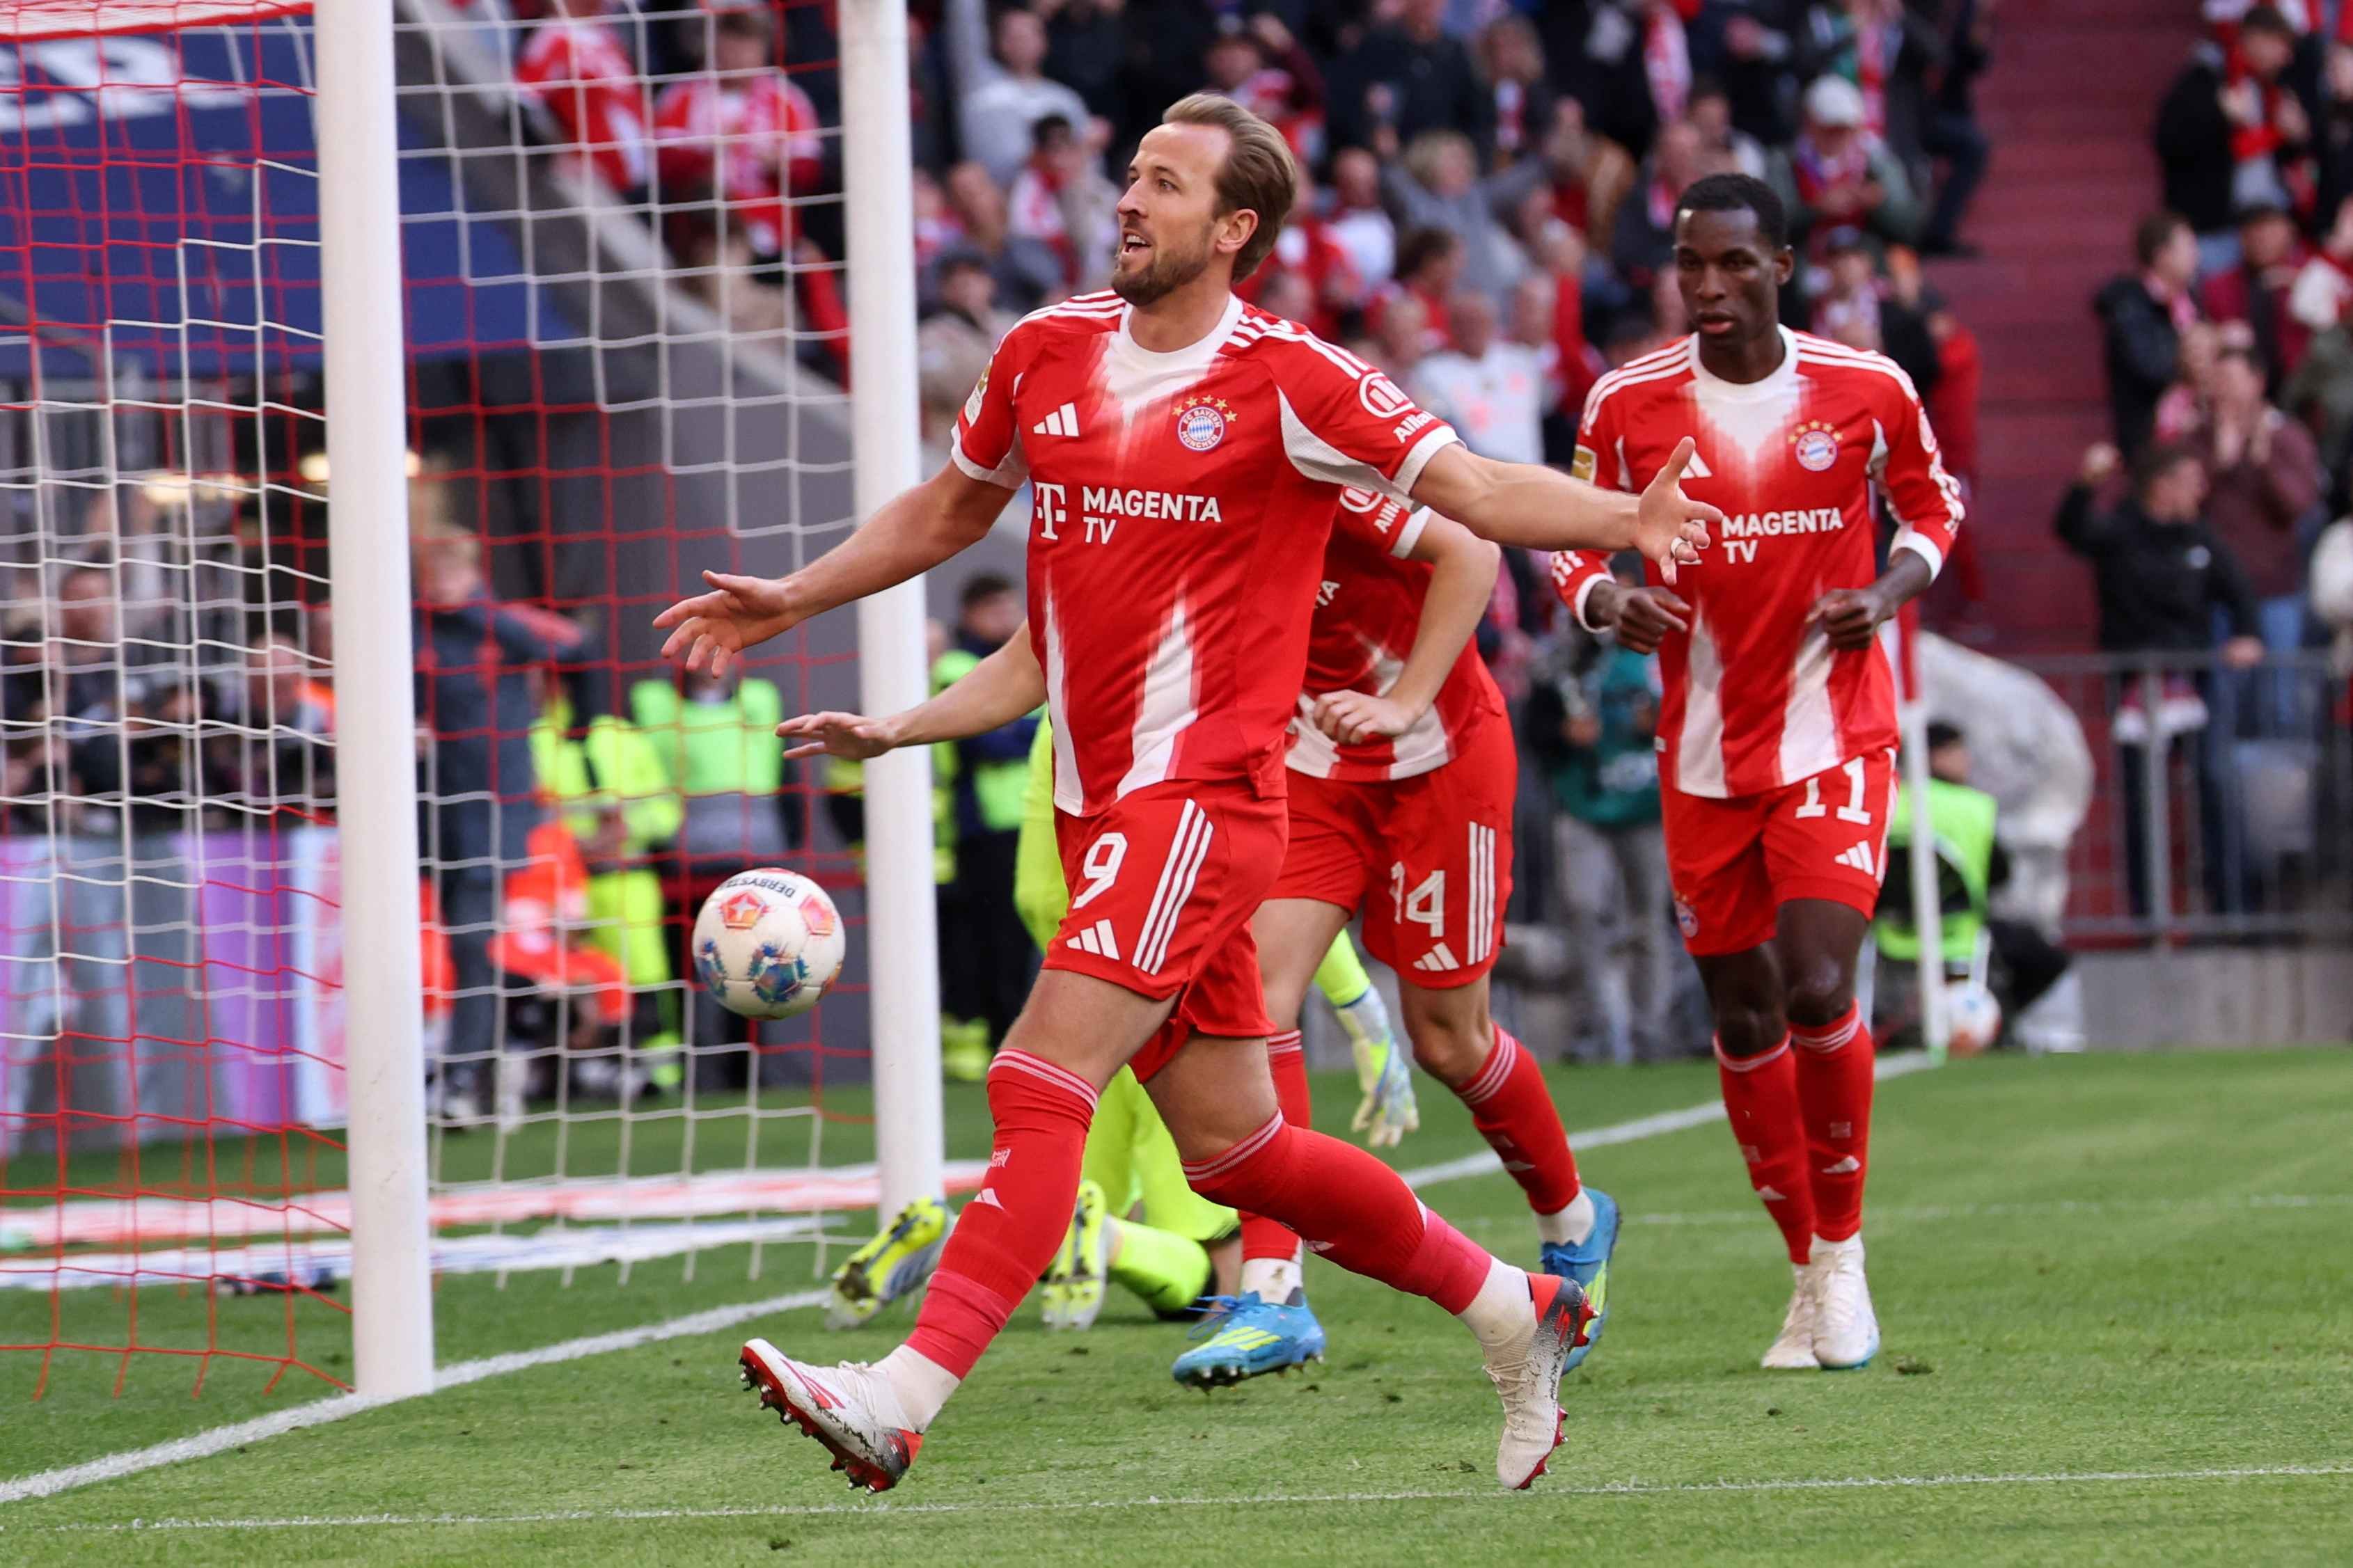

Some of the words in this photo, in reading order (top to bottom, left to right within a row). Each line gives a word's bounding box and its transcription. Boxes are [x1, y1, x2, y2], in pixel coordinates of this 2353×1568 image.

[1193, 409, 1222, 429] BAYERN
[1082, 485, 1222, 523] MAGENTA
[1082, 516, 1117, 546] TV
[1721, 507, 1845, 539] MAGENTA
[1722, 539, 1758, 565] TV
[1795, 755, 1871, 826] 11
[1071, 832, 1128, 910] 9
[1388, 860, 1445, 938] 14
